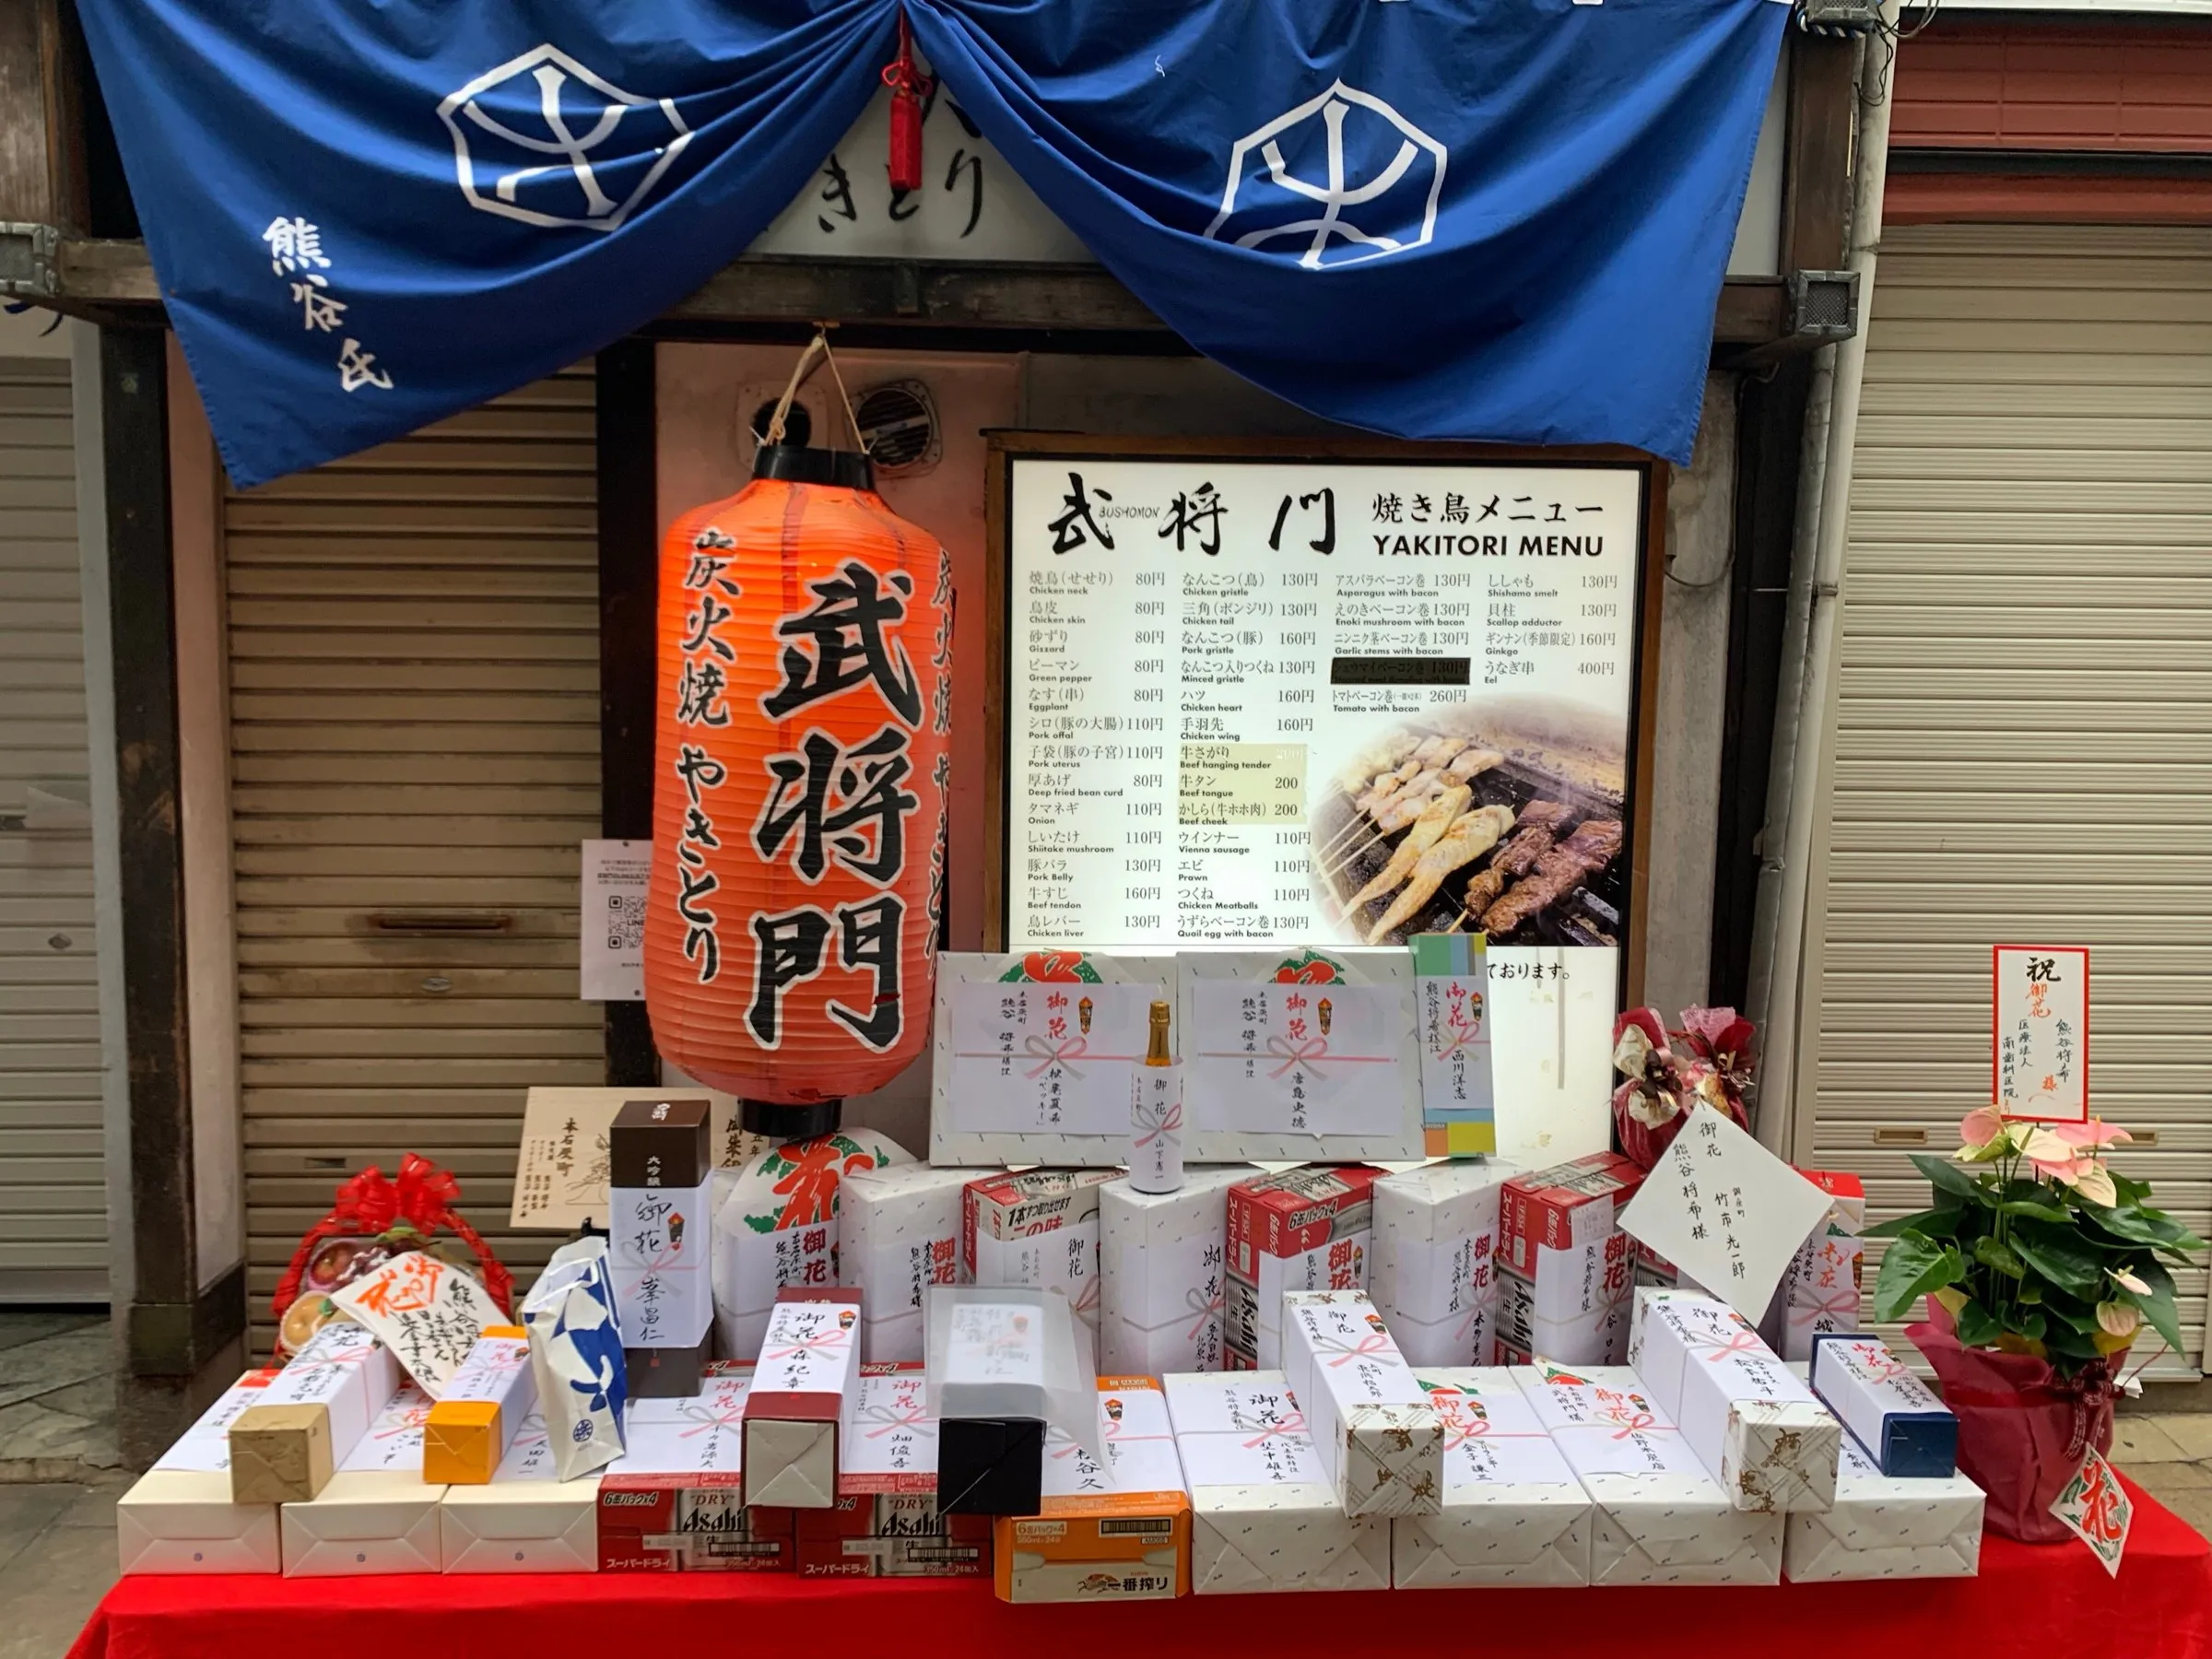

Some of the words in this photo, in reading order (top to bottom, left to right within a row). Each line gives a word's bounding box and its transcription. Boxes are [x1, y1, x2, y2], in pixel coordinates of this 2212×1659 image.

[262, 217, 394, 392] 熊谷氏
[1099, 506, 1160, 519] BUSHOMON
[1371, 492, 1604, 525] 焼き鳥メニュー
[1372, 535, 1508, 557] YAKITORI
[1519, 536, 1604, 558] MENU
[1283, 572, 1317, 586] 130円
[1336, 573, 1425, 588] アスパラベーコン巻
[1435, 573, 1470, 587] 130円
[1489, 574, 1534, 589] ししゃも
[1583, 575, 1617, 588] 130円
[1030, 585, 1065, 594] Chicken
[1067, 585, 1088, 594] neck
[1336, 588, 1385, 599] Asparagus
[1388, 588, 1408, 596] with
[1411, 588, 1439, 596] bacon
[1488, 588, 1531, 597] Shishamo
[1535, 589, 1558, 597] smelt
[1030, 600, 1058, 615] 鳥皮
[1282, 603, 1317, 617] 130円
[1335, 603, 1430, 618] えのきベーコン巻
[1434, 603, 1469, 618] 130円
[1488, 603, 1516, 617] 貝柱
[1582, 604, 1617, 618] 130円
[1030, 615, 1064, 623] Chicken
[1067, 615, 1085, 624] skin
[1335, 618, 1360, 626] Enoki
[1363, 618, 1411, 626] mushroom
[1414, 618, 1434, 626] with
[1437, 618, 1465, 626] bacon
[1487, 618, 1519, 628] Scallop
[1522, 618, 1562, 626] adductor
[678, 528, 740, 726] 炭火焼
[1281, 631, 1315, 645] 160円
[1433, 631, 1468, 645] 130円
[1581, 632, 1615, 645] 160円
[1030, 644, 1065, 653] Gizzard
[1486, 647, 1518, 657] Ginkgo
[1030, 658, 1079, 671] ピーマン
[1181, 660, 1274, 675] なんこつ入りつくね
[1279, 661, 1315, 674] 130円
[1486, 661, 1534, 676] うなぎ串
[1578, 662, 1614, 675] 400円
[1030, 673, 1056, 681] Green
[1060, 675, 1092, 684] pepper
[1485, 676, 1497, 684] Eel
[1181, 690, 1206, 700] ハツ
[1279, 689, 1314, 703] 160円
[1430, 689, 1465, 702] 260円
[1030, 702, 1068, 712] Eggplant
[1334, 704, 1367, 712] Tomato
[1392, 704, 1419, 712] bacon
[1181, 716, 1224, 732] 手羽先
[1278, 718, 1312, 732] 160円
[1029, 731, 1050, 739] Pork
[1053, 731, 1073, 739] offal
[1181, 746, 1230, 759] 牛さがり
[1180, 760, 1200, 769] Beef
[1203, 760, 1239, 771] hanging
[1241, 760, 1272, 769] tender
[1029, 773, 1071, 787] 厚あげ
[1180, 773, 1217, 788] 牛タン
[1276, 777, 1298, 789] 200
[1029, 788, 1052, 798] Deep
[1054, 788, 1076, 796] fried
[1078, 788, 1100, 796] bean
[1103, 788, 1123, 796] curd
[744, 559, 925, 1053] 武将門
[1030, 802, 1079, 817] タマネギ
[1275, 804, 1298, 818] 200
[1029, 830, 1080, 843] しいたけ
[1179, 831, 1239, 846] ウインナー
[1276, 831, 1311, 845] 110円
[675, 747, 727, 982] やきとり
[1028, 858, 1067, 873] 豚バラ
[1178, 859, 1204, 871] エビ
[1275, 860, 1310, 873] 110円
[1029, 887, 1070, 901] 牛すじ
[1178, 887, 1214, 900] つくね
[1275, 888, 1310, 901] 110円
[1028, 914, 1080, 929] 鳥レバー
[1178, 914, 1269, 929] うずらベーコン巻
[1274, 916, 1308, 929] 130円
[1178, 929, 1202, 937] Quail
[1205, 931, 1221, 939] egg
[1247, 929, 1273, 937] bacon
[2027, 957, 2061, 982] 祝
[1044, 991, 1069, 1041] 御花
[1286, 993, 1309, 1041] 御花
[1699, 1122, 1722, 1158] 御花
[1673, 1144, 1710, 1240] 熊谷将希様
[635, 1194, 672, 1254] 御花
[1714, 1192, 1745, 1279] 竹市光一郎
[1068, 1238, 1084, 1279] 御花
[683, 1508, 743, 1532] Asahi
[1108, 1577, 1169, 1591] 一番搾り
